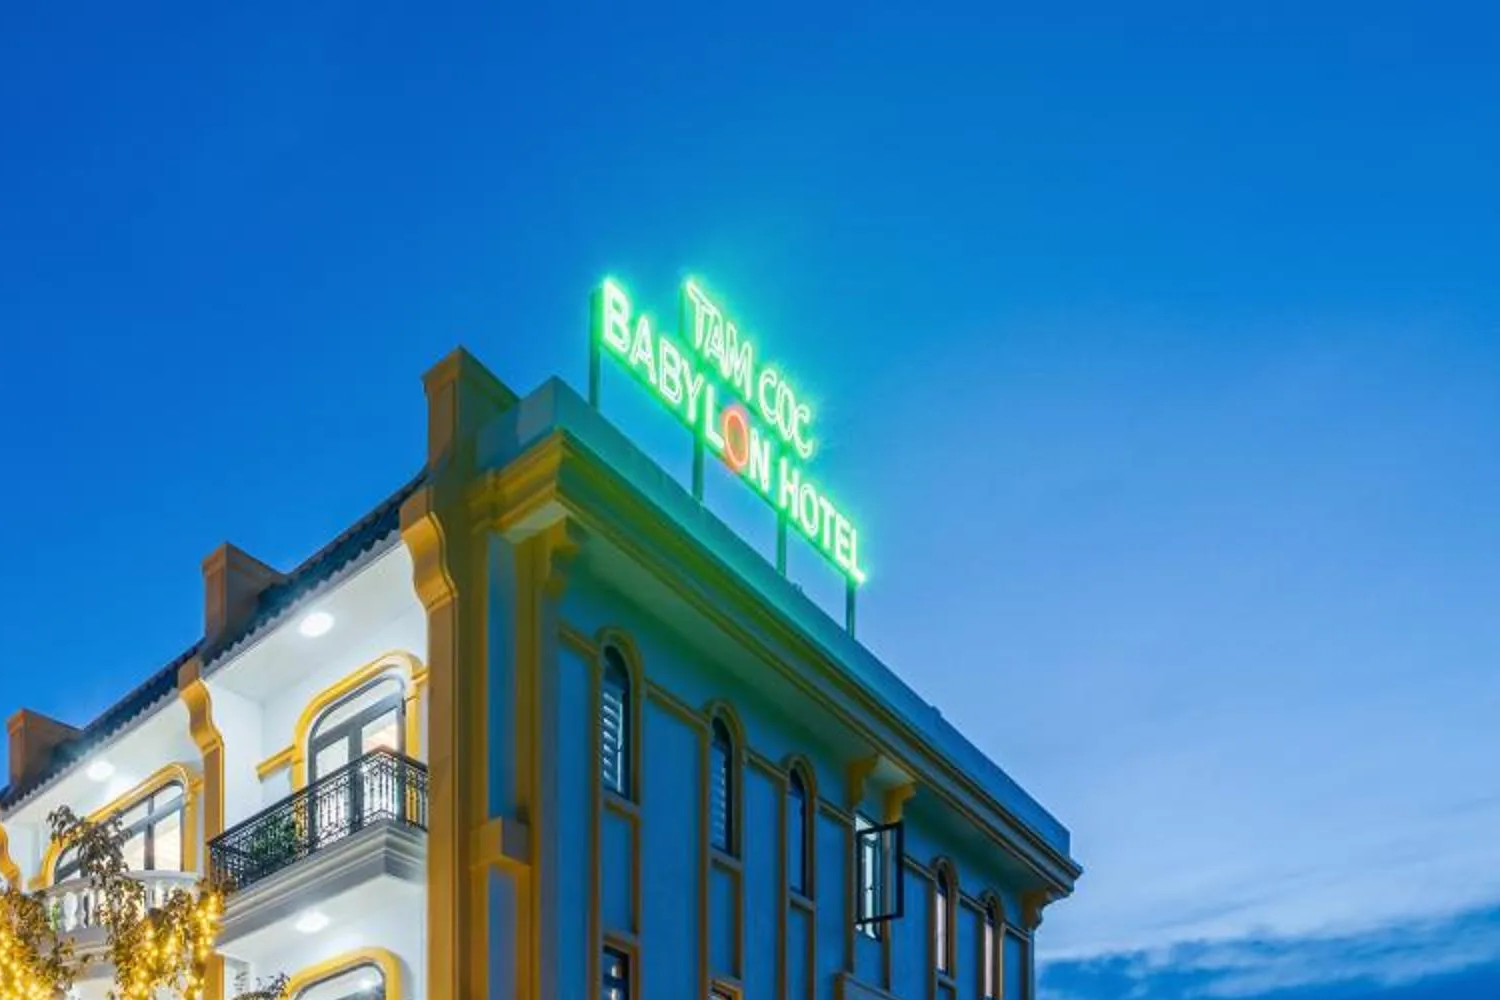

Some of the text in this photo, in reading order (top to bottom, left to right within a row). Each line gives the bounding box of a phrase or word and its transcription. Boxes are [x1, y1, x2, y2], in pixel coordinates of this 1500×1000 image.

[603, 280, 864, 582] BABYLON HOTEL
[686, 280, 753, 400] TAM
